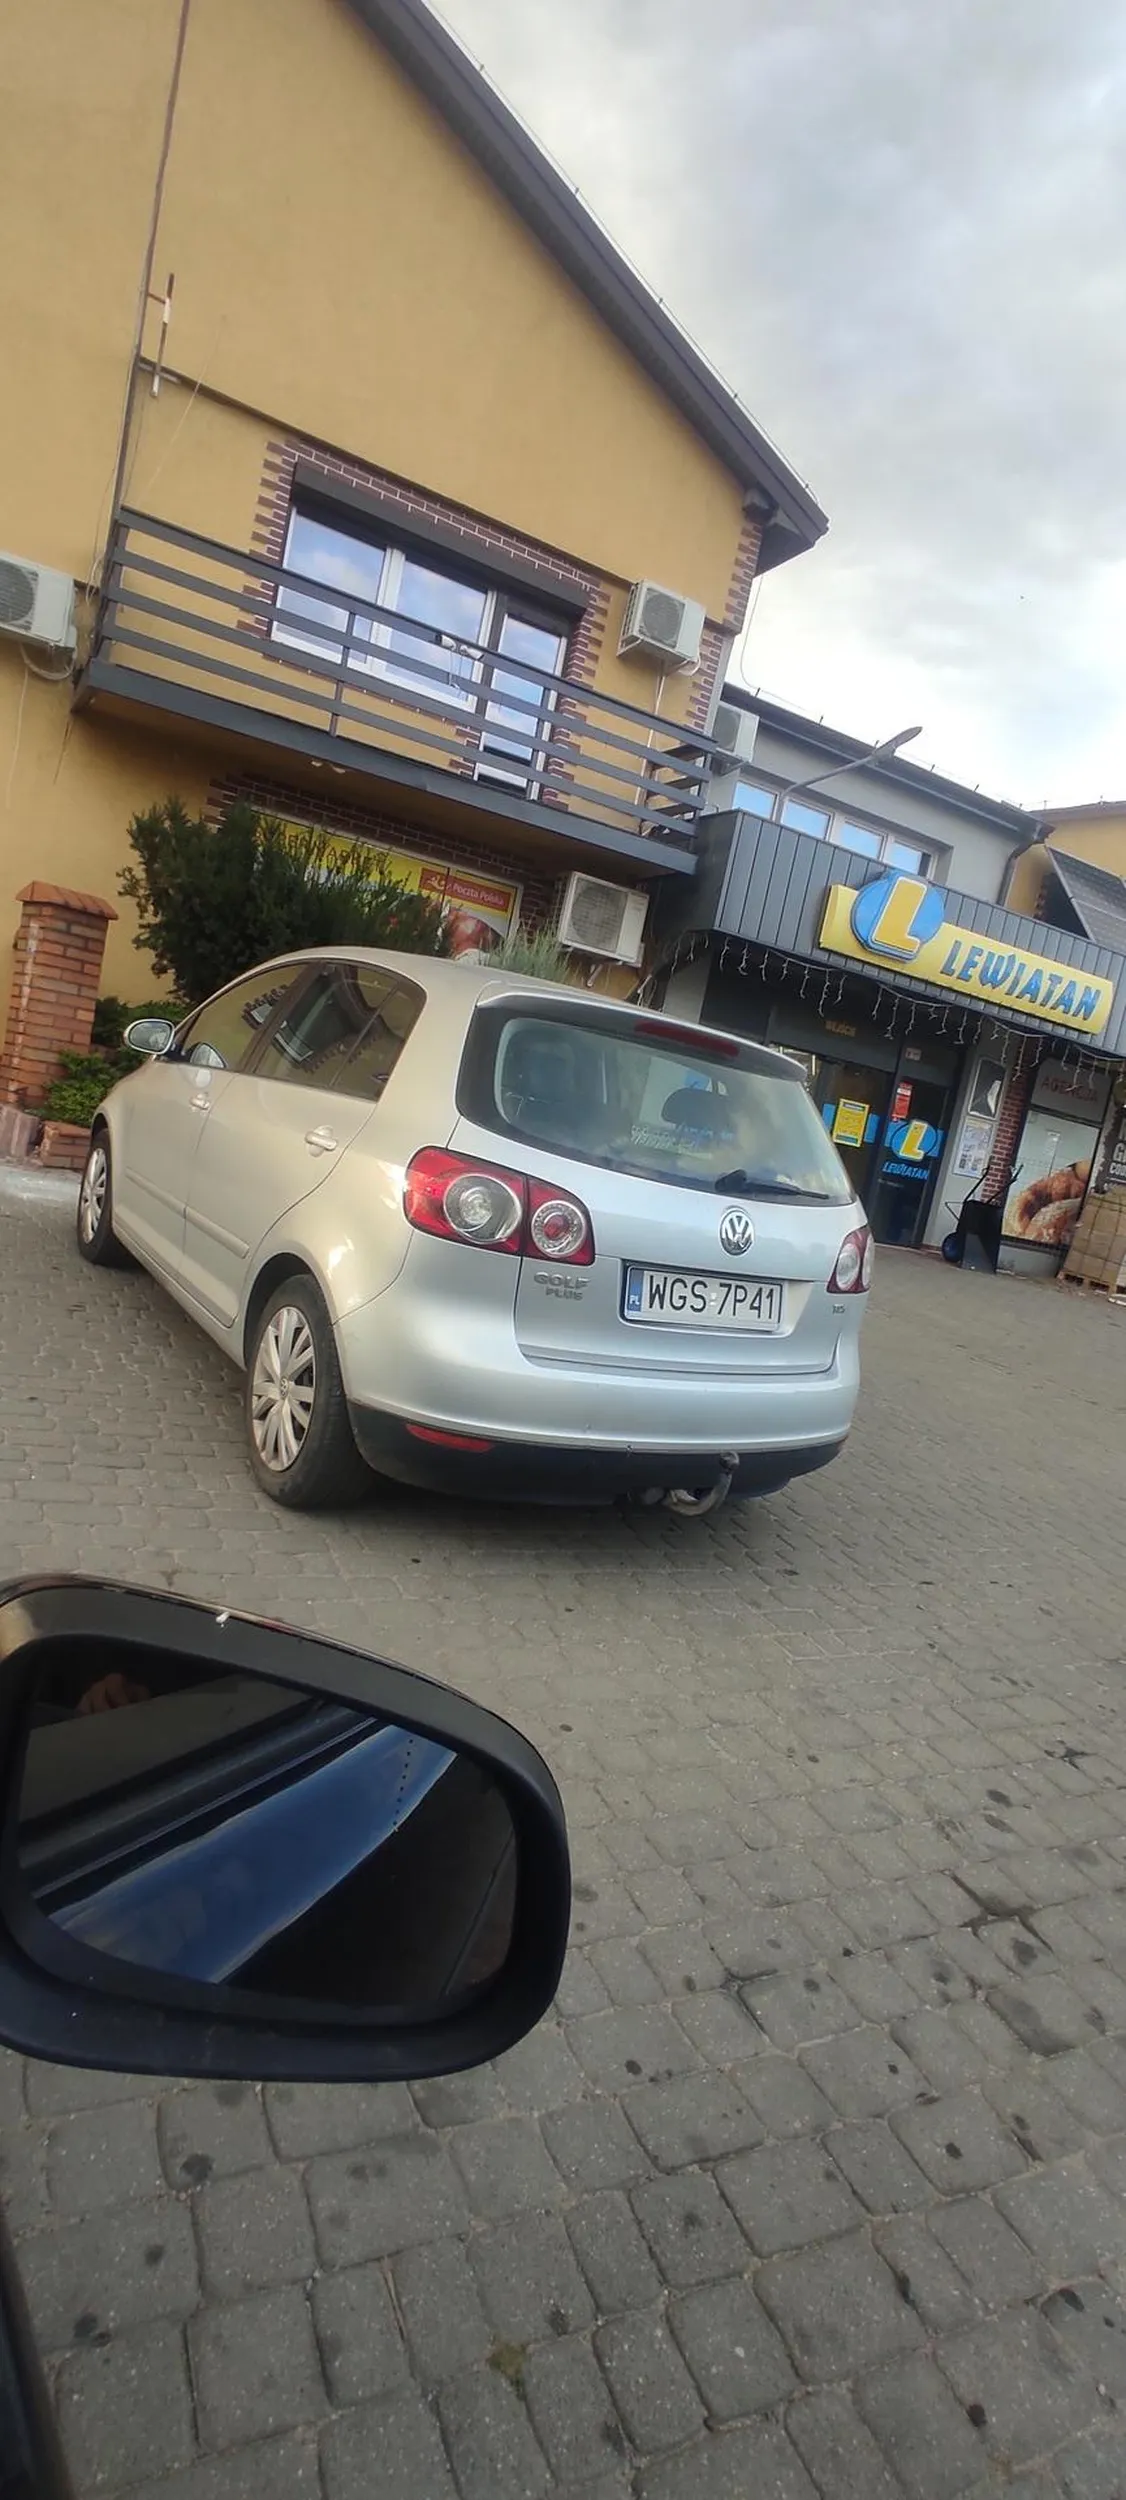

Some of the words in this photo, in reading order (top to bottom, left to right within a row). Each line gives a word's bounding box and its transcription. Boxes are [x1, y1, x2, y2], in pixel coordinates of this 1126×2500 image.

[452, 883, 479, 898] Poczta
[940, 939, 1102, 1021] LEWIATAN
[882, 1161, 929, 1180] LEWIATAN
[534, 1271, 590, 1289] GOLF
[545, 1287, 583, 1301] PLUS
[629, 1294, 640, 1305] PL
[648, 1275, 708, 1313] WGS
[717, 1282, 774, 1319] 7P41
